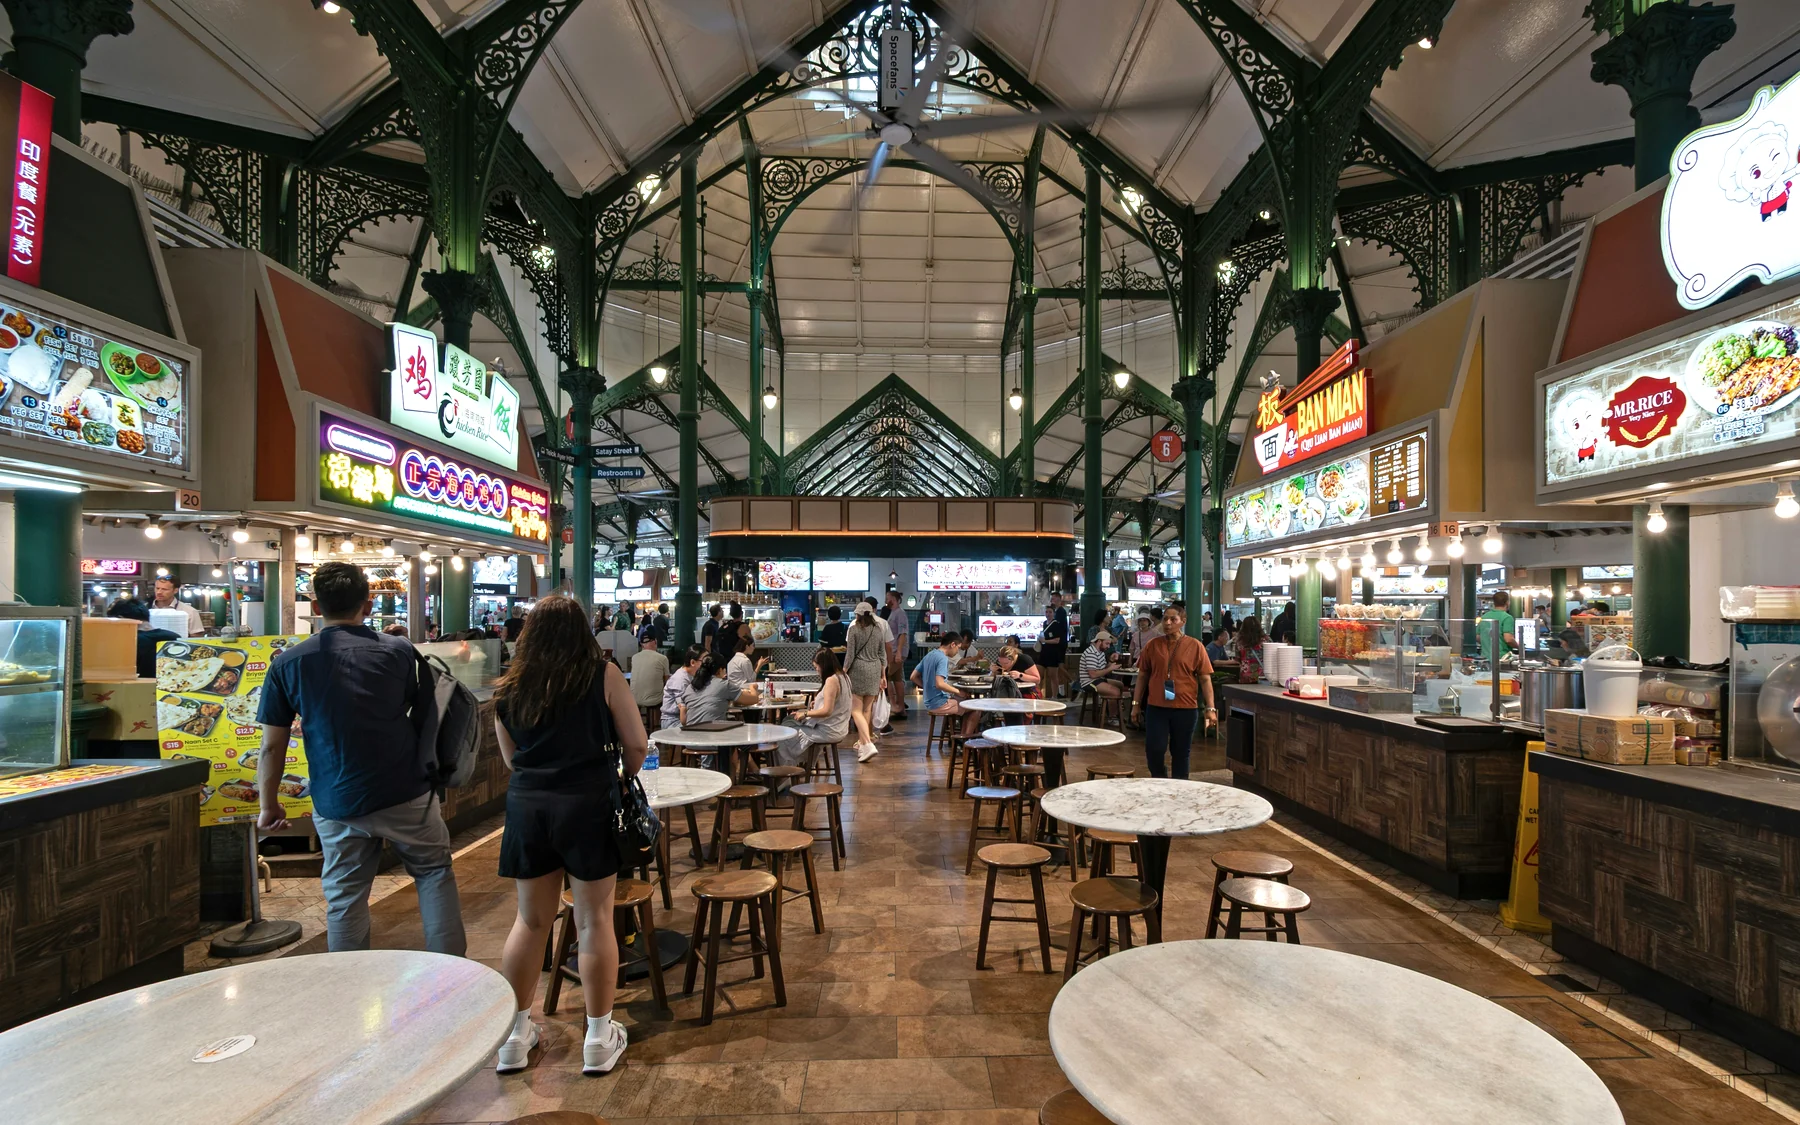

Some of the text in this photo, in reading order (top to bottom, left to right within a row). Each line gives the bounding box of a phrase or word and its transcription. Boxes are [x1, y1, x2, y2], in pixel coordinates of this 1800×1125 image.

[889, 35, 899, 89] Spacefans
[55, 328, 66, 339] 12
[44, 336, 99, 360] FISH SET MEAL
[405, 345, 432, 400] 鸡
[24, 397, 36, 407] 13
[1297, 370, 1364, 438] BAN MIAN
[1718, 404, 1729, 413] 06
[11, 406, 67, 426] VEG SET MEAL
[1329, 426, 1341, 440] BAN
[595, 447, 632, 456] Satay Street
[1163, 442, 1170, 457] 6
[406, 461, 503, 509] 正宗海南鸡饭
[183, 494, 199, 507] 20
[1430, 525, 1438, 535] 16
[1444, 524, 1456, 534] 16
[246, 663, 266, 671] $12.5
[1525, 816, 1537, 824] WET
